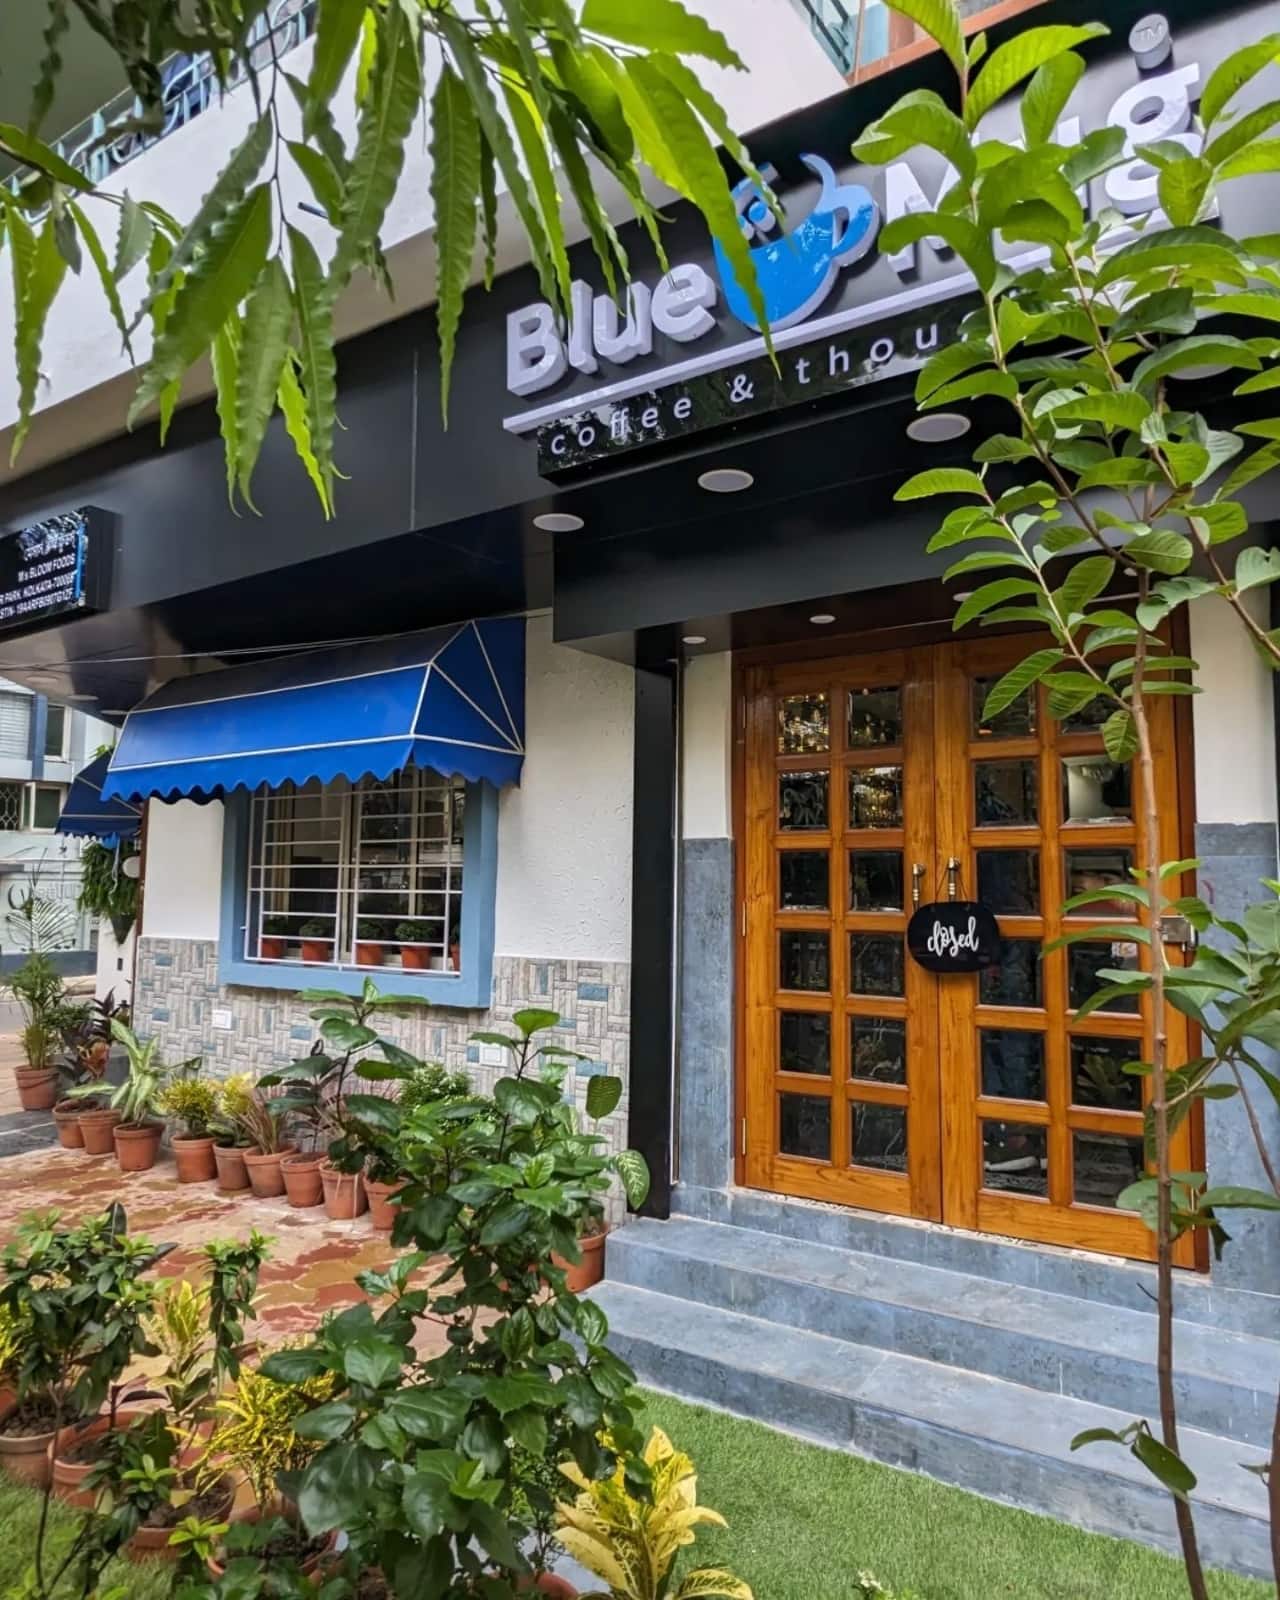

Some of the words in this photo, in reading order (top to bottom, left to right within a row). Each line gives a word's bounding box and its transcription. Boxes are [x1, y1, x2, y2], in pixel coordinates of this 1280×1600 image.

[507, 263, 717, 396] Blue
[550, 397, 692, 455] coffee
[730, 374, 755, 403] &
[53, 554, 75, 570] FOODS
[927, 916, 980, 957] closed
